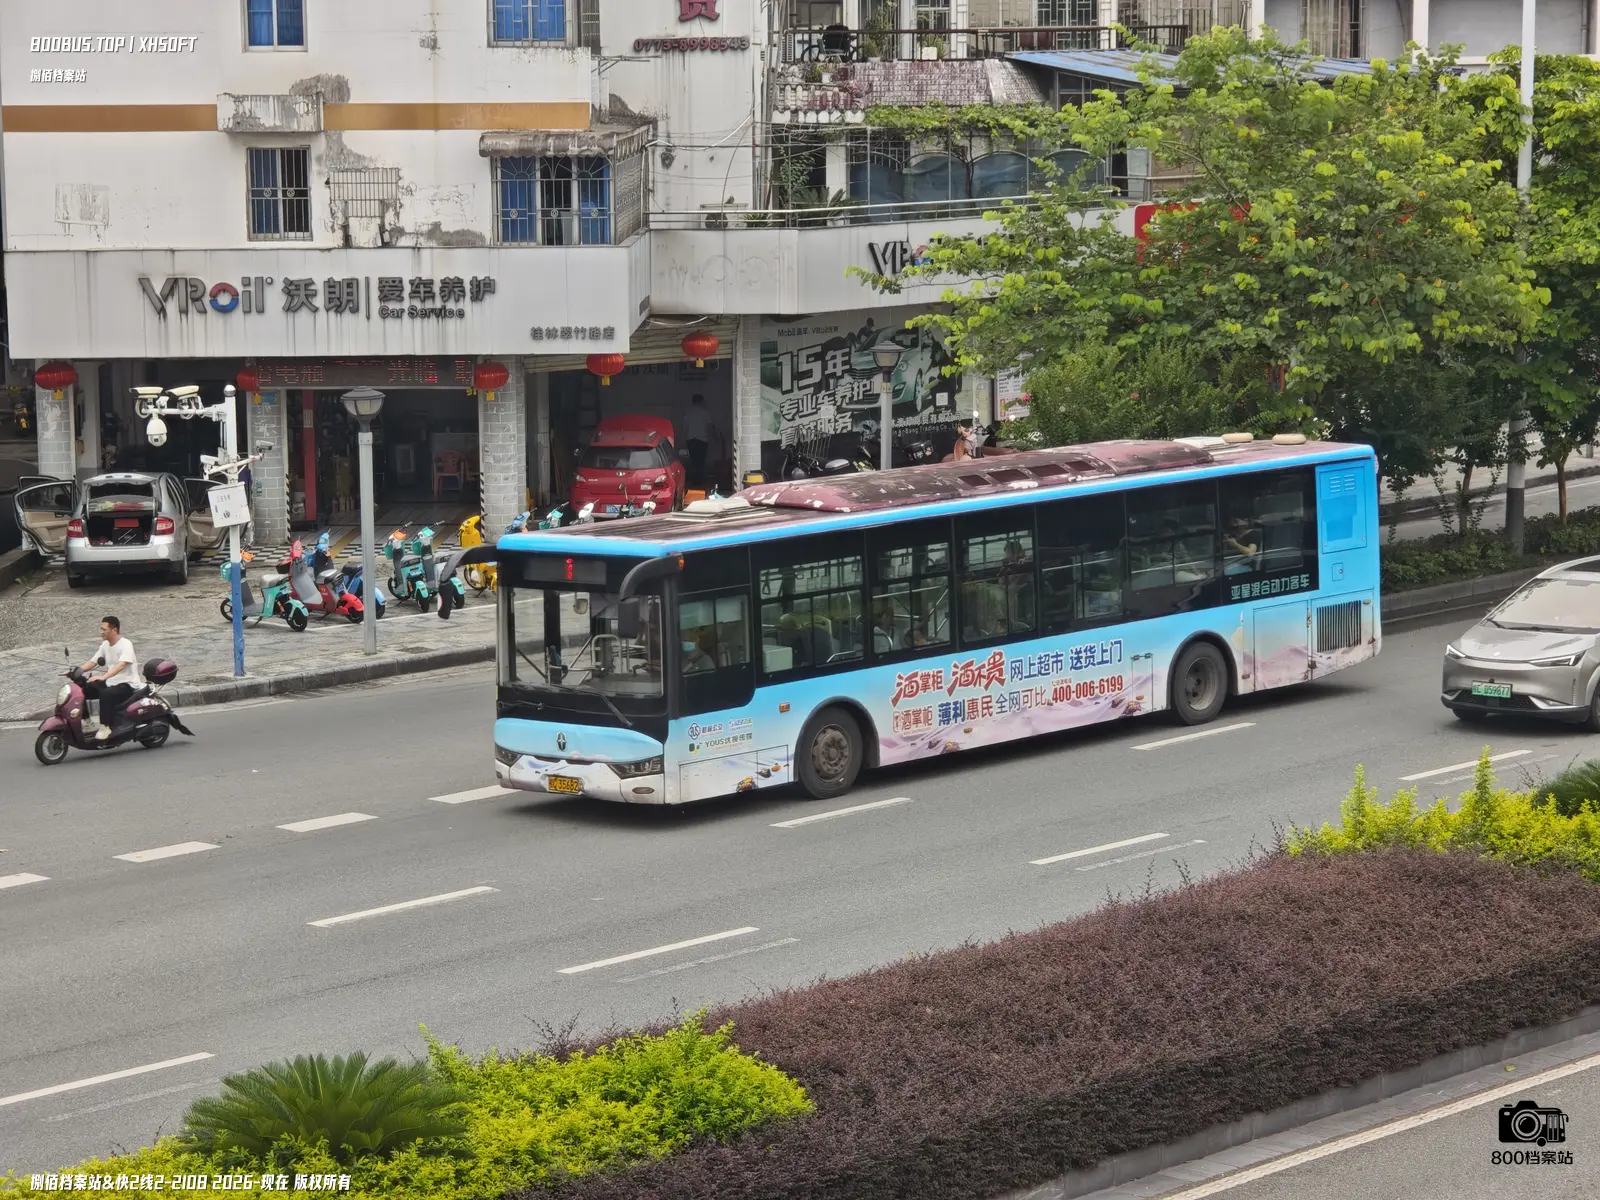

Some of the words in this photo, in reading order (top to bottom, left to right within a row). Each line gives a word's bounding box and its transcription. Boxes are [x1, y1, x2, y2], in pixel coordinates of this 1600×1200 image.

[633, 36, 750, 51] 0773-8998543
[281, 277, 359, 314] 沃朗
[377, 276, 496, 303] 爱车养护
[378, 306, 405, 318] Car
[407, 305, 465, 319] Service
[530, 326, 615, 341] 桂林翠竹路店
[777, 345, 850, 393] 15年
[1231, 574, 1310, 600] 亚星混合动力客车
[891, 669, 944, 708] 酒掌柜
[947, 650, 1006, 697] 酒不贵
[1010, 651, 1064, 682] 网上超市
[1069, 640, 1122, 671] 送货上门
[1052, 674, 1124, 704] 400-006-6199
